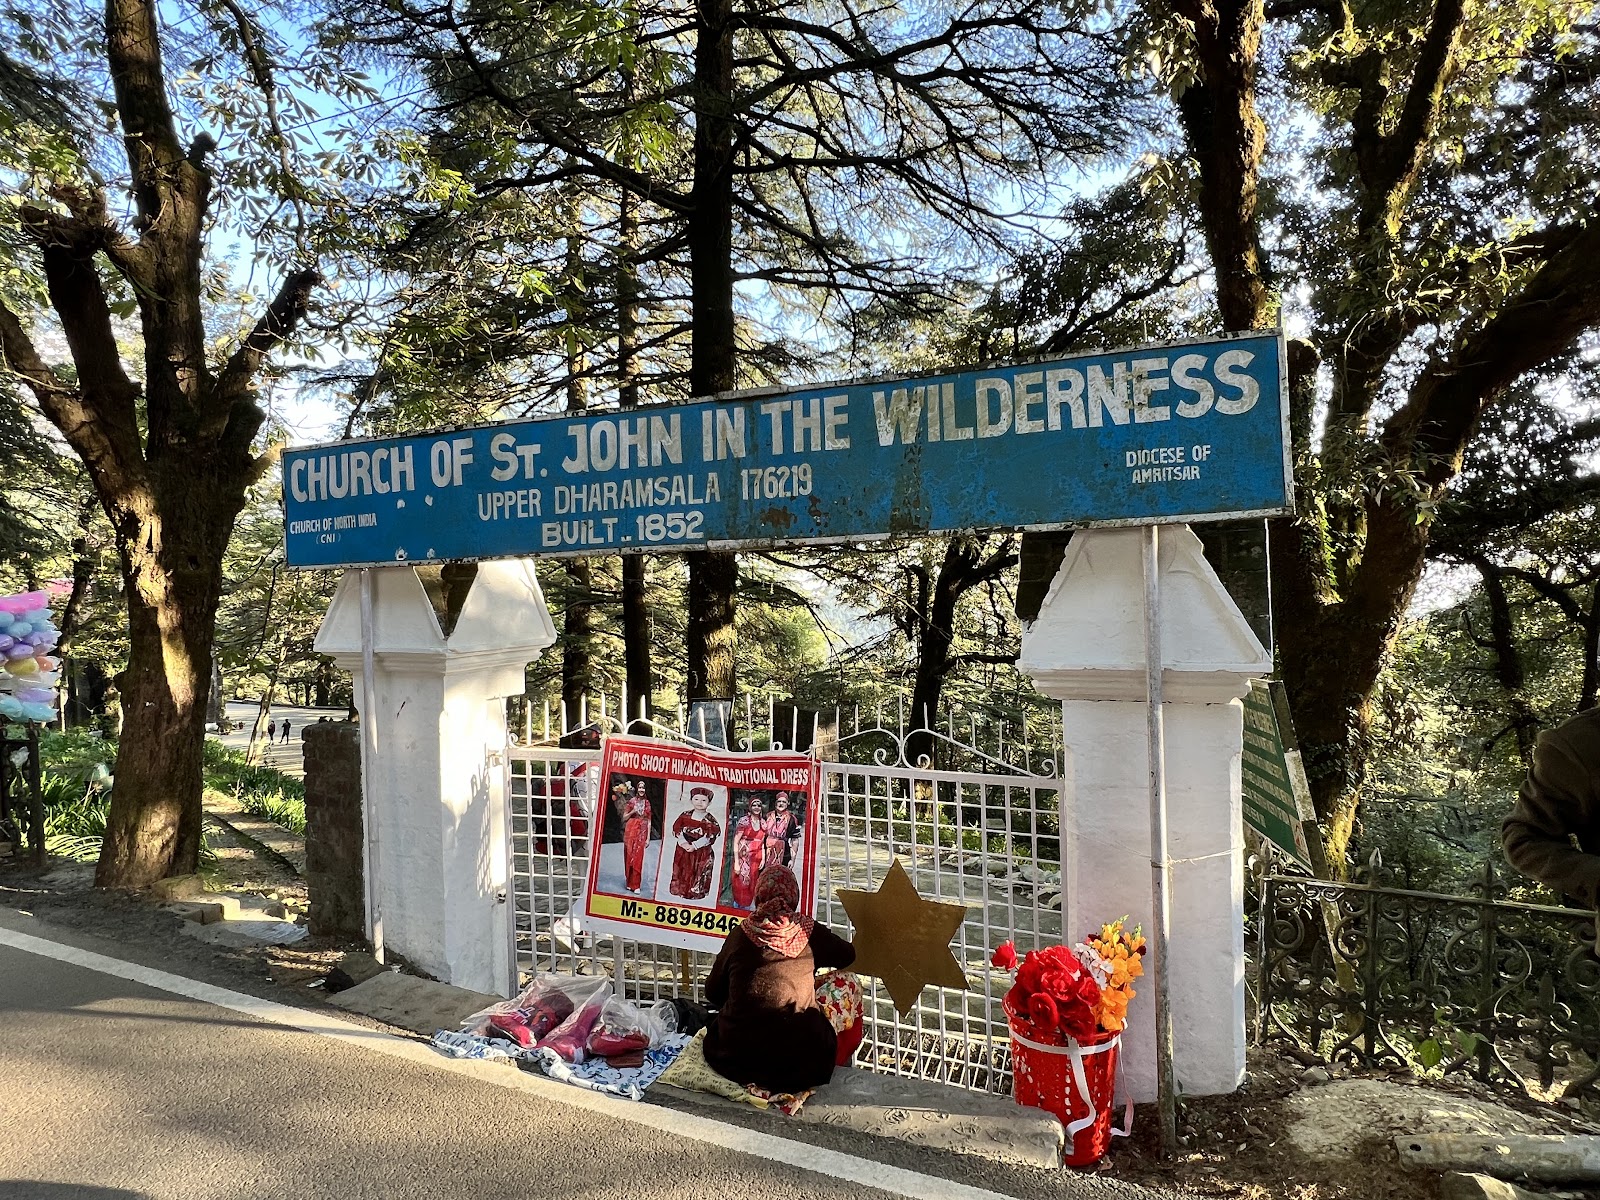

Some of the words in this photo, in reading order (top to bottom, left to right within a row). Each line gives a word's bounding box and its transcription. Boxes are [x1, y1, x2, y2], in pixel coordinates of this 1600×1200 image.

[289, 445, 415, 503] CHURCH
[430, 437, 474, 488] OF
[562, 414, 683, 474] JOHN
[702, 406, 746, 462] IN
[761, 394, 850, 455] THE
[873, 349, 1261, 447] WILDERNESS
[1126, 446, 1185, 467] DIOCESE
[1192, 444, 1211, 462] OF
[1132, 465, 1200, 483] AMRITSAR
[478, 488, 541, 521] UPPER
[555, 472, 720, 514] DHARAMSALA
[741, 463, 812, 500] 176219
[290, 519, 320, 534] CHURCH
[322, 517, 333, 531] OF
[334, 514, 356, 530] NORTH
[358, 512, 377, 527] INDIA
[636, 510, 704, 541] 1852
[612, 751, 639, 768] PHOTO
[641, 757, 671, 774] SHOOT
[671, 757, 717, 780] HIMACHALI
[718, 766, 779, 785] TRADITIONAL
[781, 768, 809, 786] DRESS
